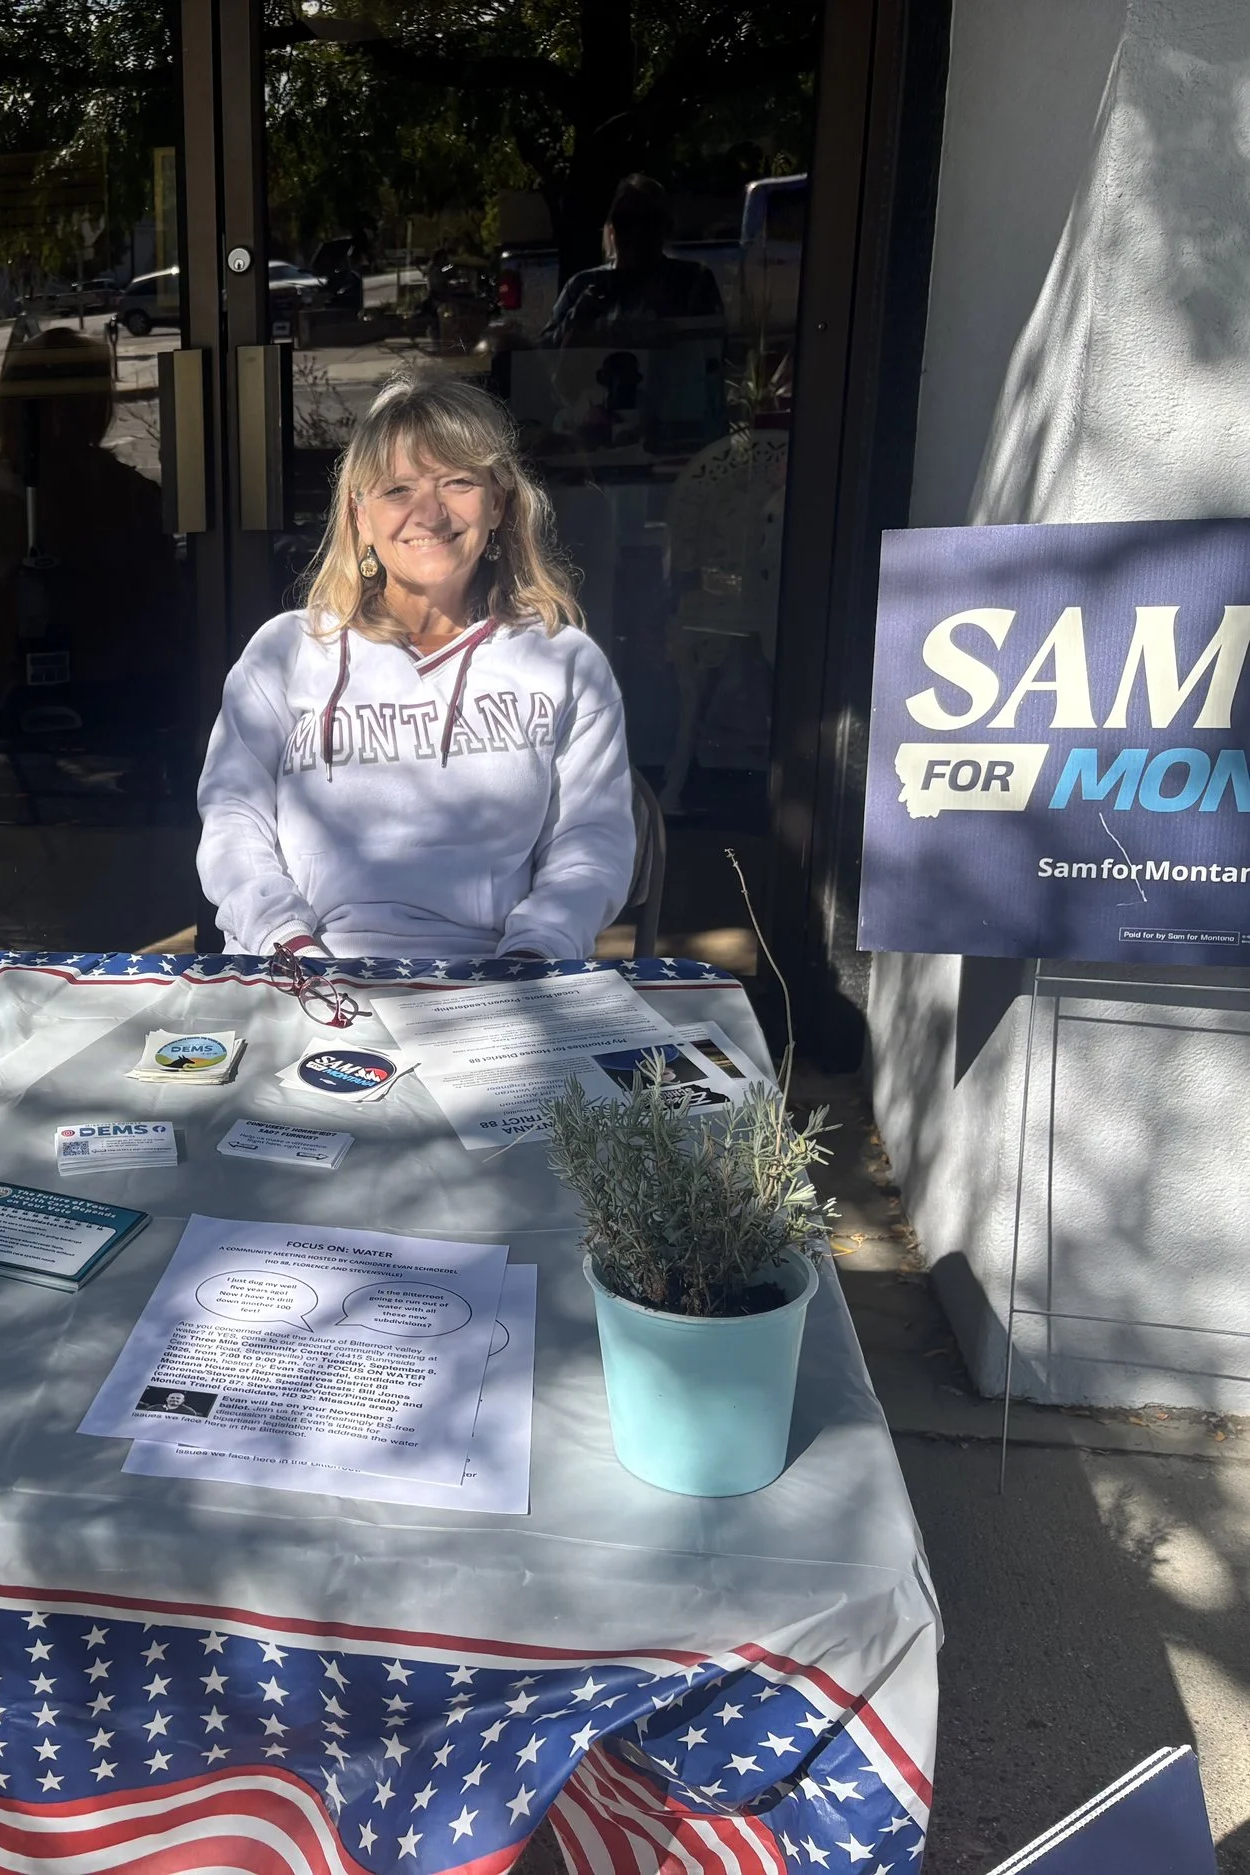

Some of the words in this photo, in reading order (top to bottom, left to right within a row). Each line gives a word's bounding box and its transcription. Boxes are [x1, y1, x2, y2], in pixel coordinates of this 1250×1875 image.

[905, 605, 1250, 731] SAM
[283, 691, 556, 776] MONTANA
[921, 759, 1015, 792] FOR
[1123, 931, 1141, 939] Paid
[1200, 934, 1235, 942] Montana
[554, 990, 580, 998] Local
[431, 1002, 487, 1012] Leadership.
[488, 998, 521, 1006] Proven
[171, 1045, 213, 1053] DEMS
[567, 1040, 610, 1051] Priorities
[482, 1052, 518, 1061] District
[519, 1048, 551, 1057] House
[315, 1056, 362, 1074] SAM
[323, 1067, 376, 1087] MONTANA
[494, 1087, 531, 1096] Veteran
[480, 1120, 498, 1129] 88
[502, 1113, 543, 1126] TRICT
[79, 1124, 149, 1137] DEMS
[246, 1121, 290, 1131] CONFUSED?
[291, 1128, 338, 1137] HORRIFIED?
[502, 1120, 553, 1134] NTANA
[281, 1132, 319, 1140] FURIOUS?
[12, 1194, 46, 1204] Health
[47, 1199, 70, 1208] Care
[72, 1205, 117, 1219] Depends
[17, 1189, 34, 1197] The
[36, 1193, 70, 1203] Future
[86, 1202, 111, 1211] Your
[21, 1200, 46, 1209] Your
[47, 1206, 72, 1214] Vote
[18, 1215, 58, 1228] candidates
[286, 1240, 325, 1250] FOCUS
[325, 1244, 349, 1253] ON:
[351, 1247, 393, 1258] WATER
[225, 1246, 273, 1255] COMMUNITY
[272, 1251, 307, 1259] MEETING
[306, 1254, 337, 1262] HOSTED
[348, 1259, 391, 1268] CANDIDATE
[414, 1265, 458, 1274] SCHROEDEL
[291, 1261, 330, 1270] FLORENCE
[368, 1295, 393, 1303] going
[401, 1291, 444, 1300] Bitterroot
[165, 1344, 192, 1353] 2026,
[193, 1348, 217, 1356] from
[218, 1351, 240, 1359] 7:00
[254, 1355, 276, 1363] 9:00
[326, 1364, 364, 1373] FOCUS
[366, 1368, 383, 1376] ON
[385, 1370, 426, 1381] WATER
